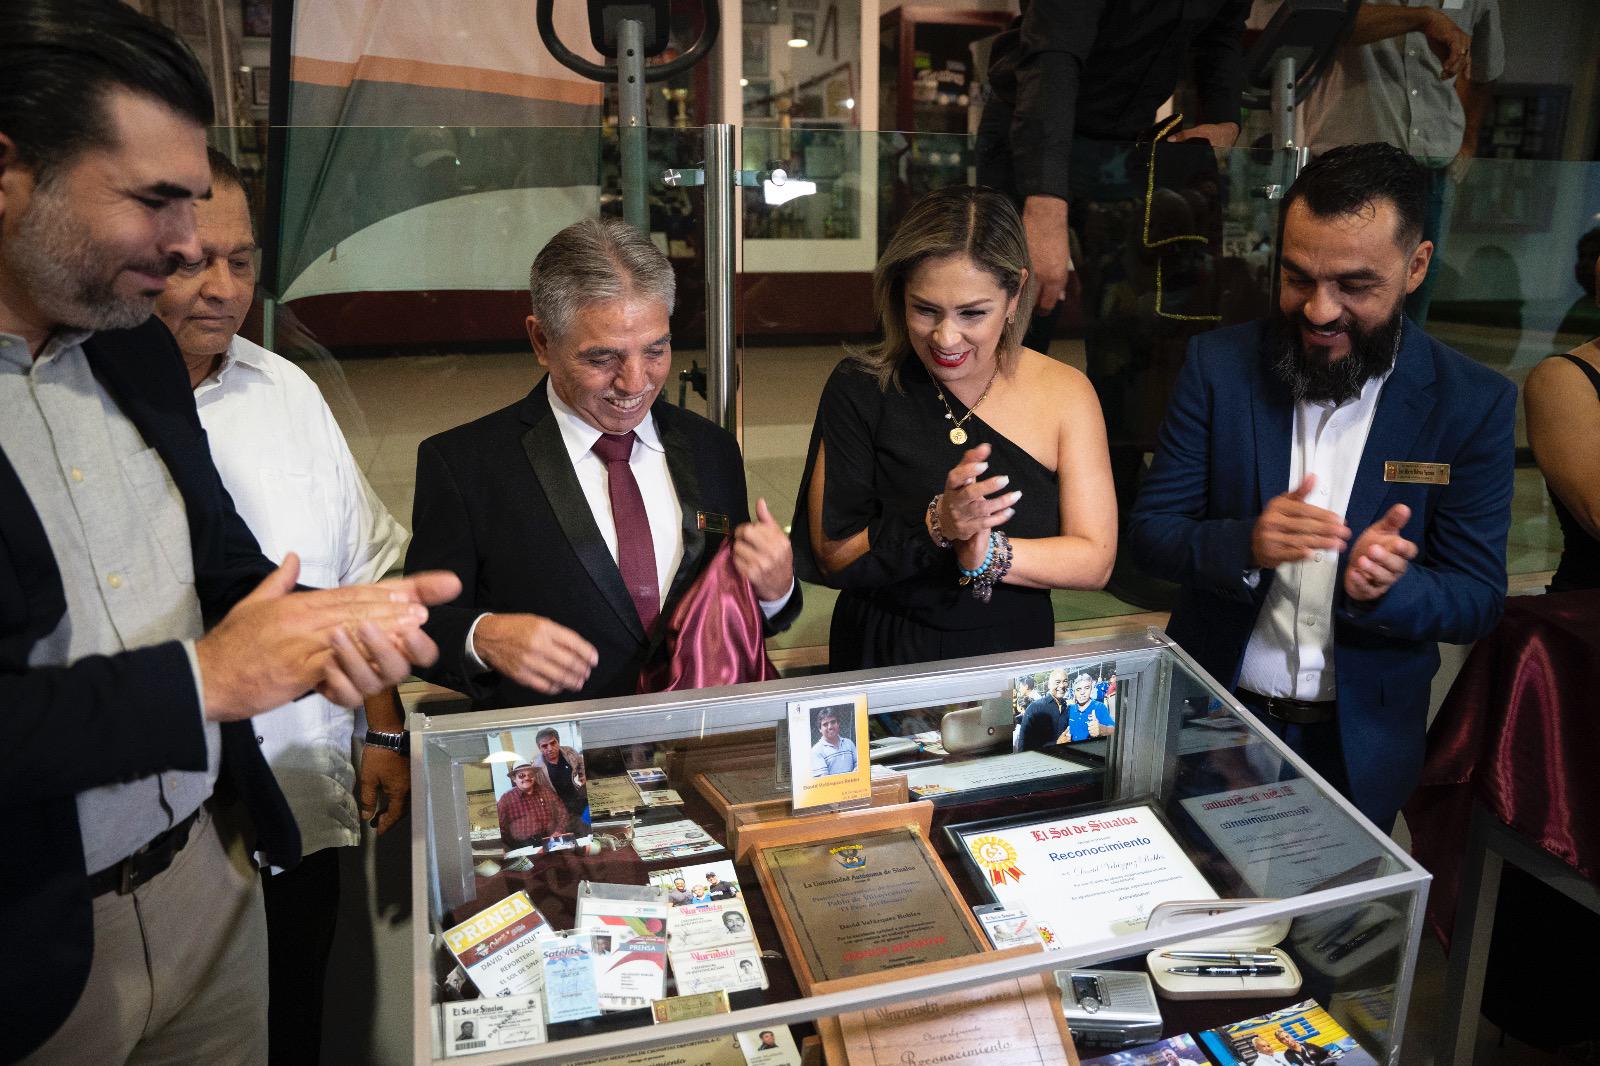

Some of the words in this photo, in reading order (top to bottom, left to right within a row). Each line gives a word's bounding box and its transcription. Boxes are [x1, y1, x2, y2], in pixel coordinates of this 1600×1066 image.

[1030, 829, 1048, 843] El
[1052, 825, 1072, 840] Sol
[1074, 823, 1087, 834] de
[1089, 815, 1139, 833] Sinaloa
[1048, 836, 1151, 862] Reconocimiento
[803, 880, 813, 889] La
[813, 874, 850, 888] Universidad
[884, 868, 892, 876] de
[892, 864, 917, 874] Sinaloa
[449, 898, 529, 949] PRENSA
[839, 920, 861, 930] David
[897, 911, 921, 921] Robles
[481, 955, 503, 971] DAVID
[506, 932, 540, 957] VELAZQU
[629, 944, 656, 952] PRENSA
[500, 949, 536, 973] REPORTERO
[519, 966, 527, 975] DE
[453, 1008, 460, 1017] El
[461, 1006, 472, 1016] Sol
[472, 1005, 479, 1014] de
[480, 1003, 504, 1014] Sinaloa
[900, 1040, 1013, 1066] Reconocimiento
